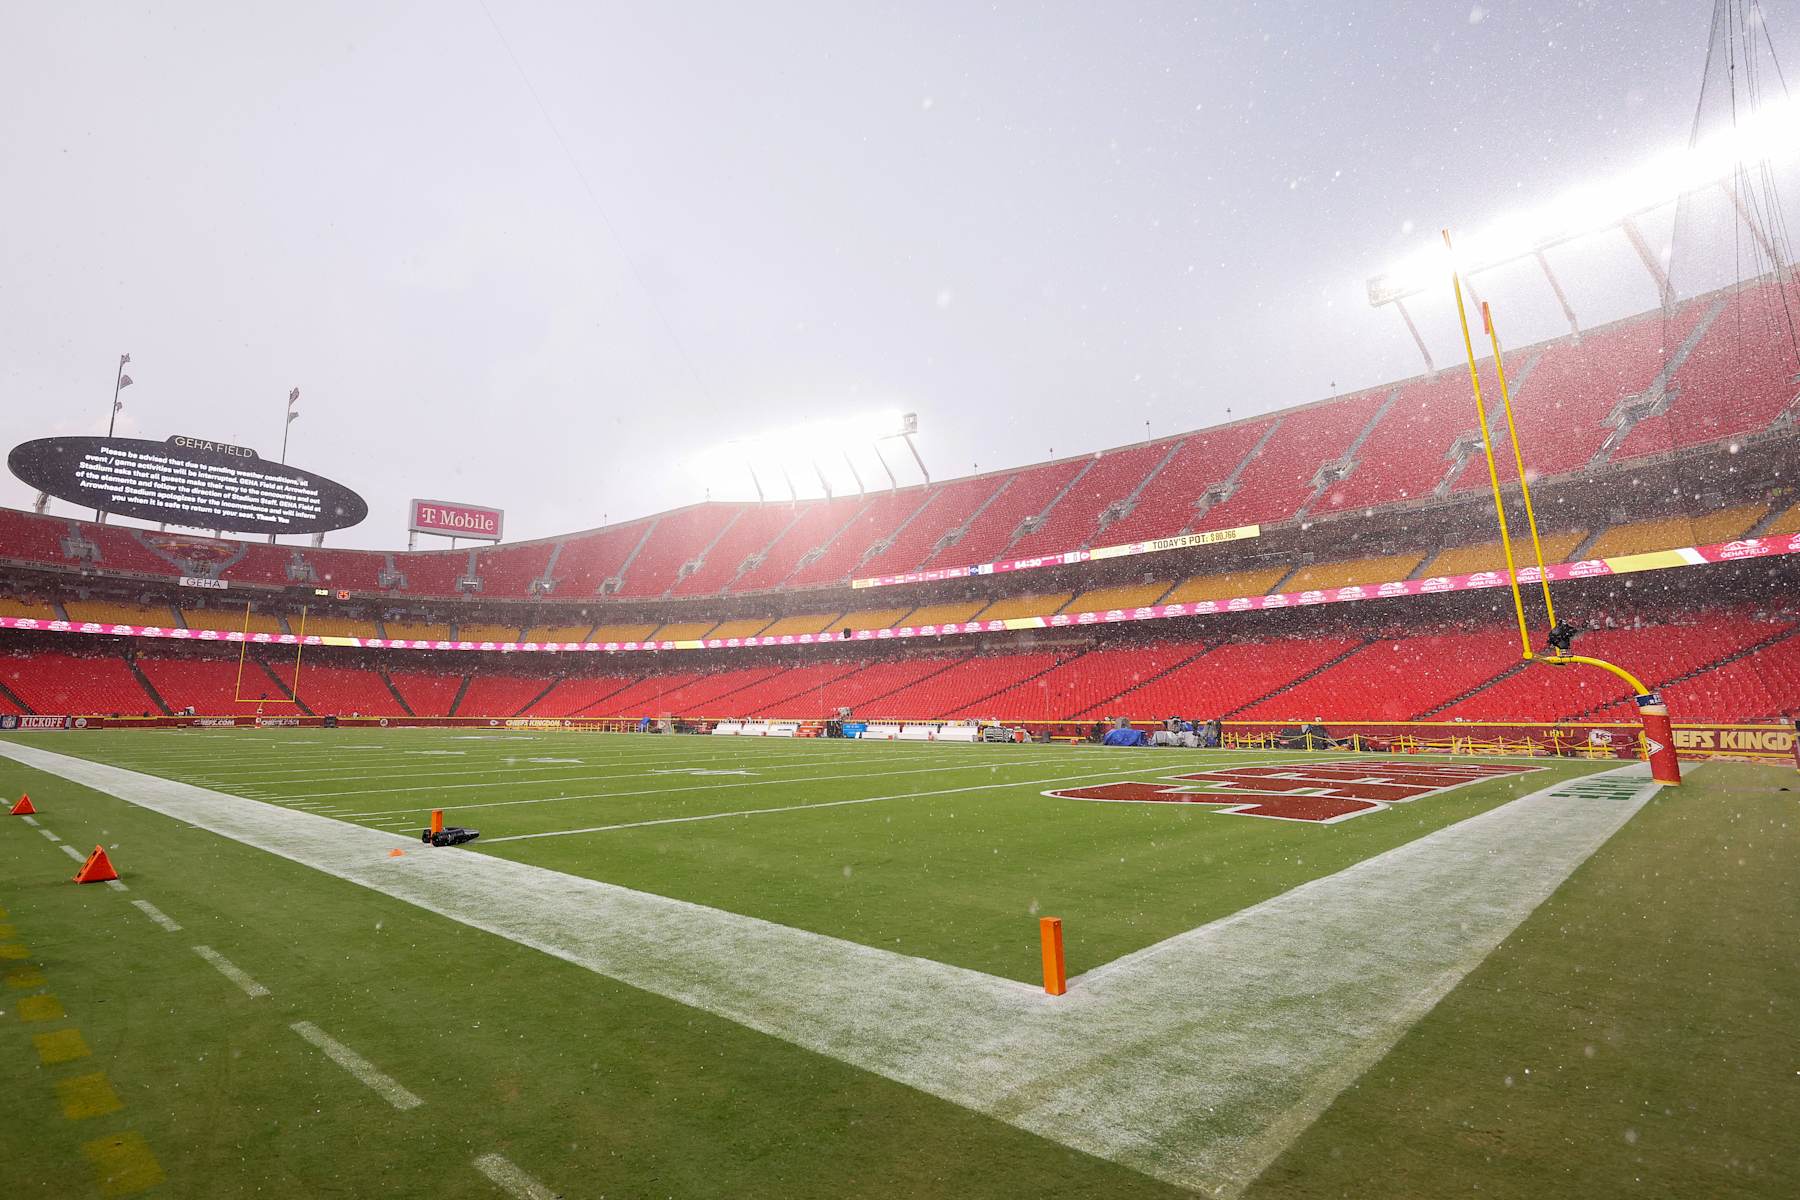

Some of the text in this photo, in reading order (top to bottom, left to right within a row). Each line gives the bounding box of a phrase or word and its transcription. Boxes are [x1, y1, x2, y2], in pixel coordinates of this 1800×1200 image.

[175, 437, 253, 458] GEHA FIELD
[101, 447, 127, 457] Please
[139, 454, 168, 464] advised
[169, 458, 184, 466] that
[185, 460, 198, 468] due
[200, 462, 207, 470] to
[208, 466, 235, 475] pending
[237, 470, 264, 479] weather
[80, 462, 112, 472] Stadium
[114, 467, 131, 475] asks
[133, 470, 149, 478] that
[161, 475, 185, 483] guests
[207, 481, 224, 489] their
[85, 455, 108, 463] event
[138, 462, 172, 473] activities
[173, 467, 186, 475] will
[240, 478, 258, 486] GEHA
[284, 486, 318, 496] Arrowhead
[80, 481, 123, 492] Arrowhead
[125, 487, 156, 496] Stadium
[158, 492, 195, 502] apologizes
[86, 472, 99, 480] the
[101, 475, 136, 485] elements
[154, 481, 177, 491] follow
[191, 487, 222, 497] direction
[232, 494, 259, 503] Stadium
[127, 496, 148, 504] when
[191, 505, 212, 513] return
[440, 509, 494, 531] Mobile
[1153, 537, 1187, 549] TODAY'S
[1189, 535, 1209, 545] POT:
[1720, 547, 1769, 558] GEHA FIELD
[1589, 567, 1609, 575] FIELD
[186, 578, 221, 588] GEHA
[21, 718, 63, 728] KICKOFF
[1672, 730, 1793, 751] IEFS KINGD
